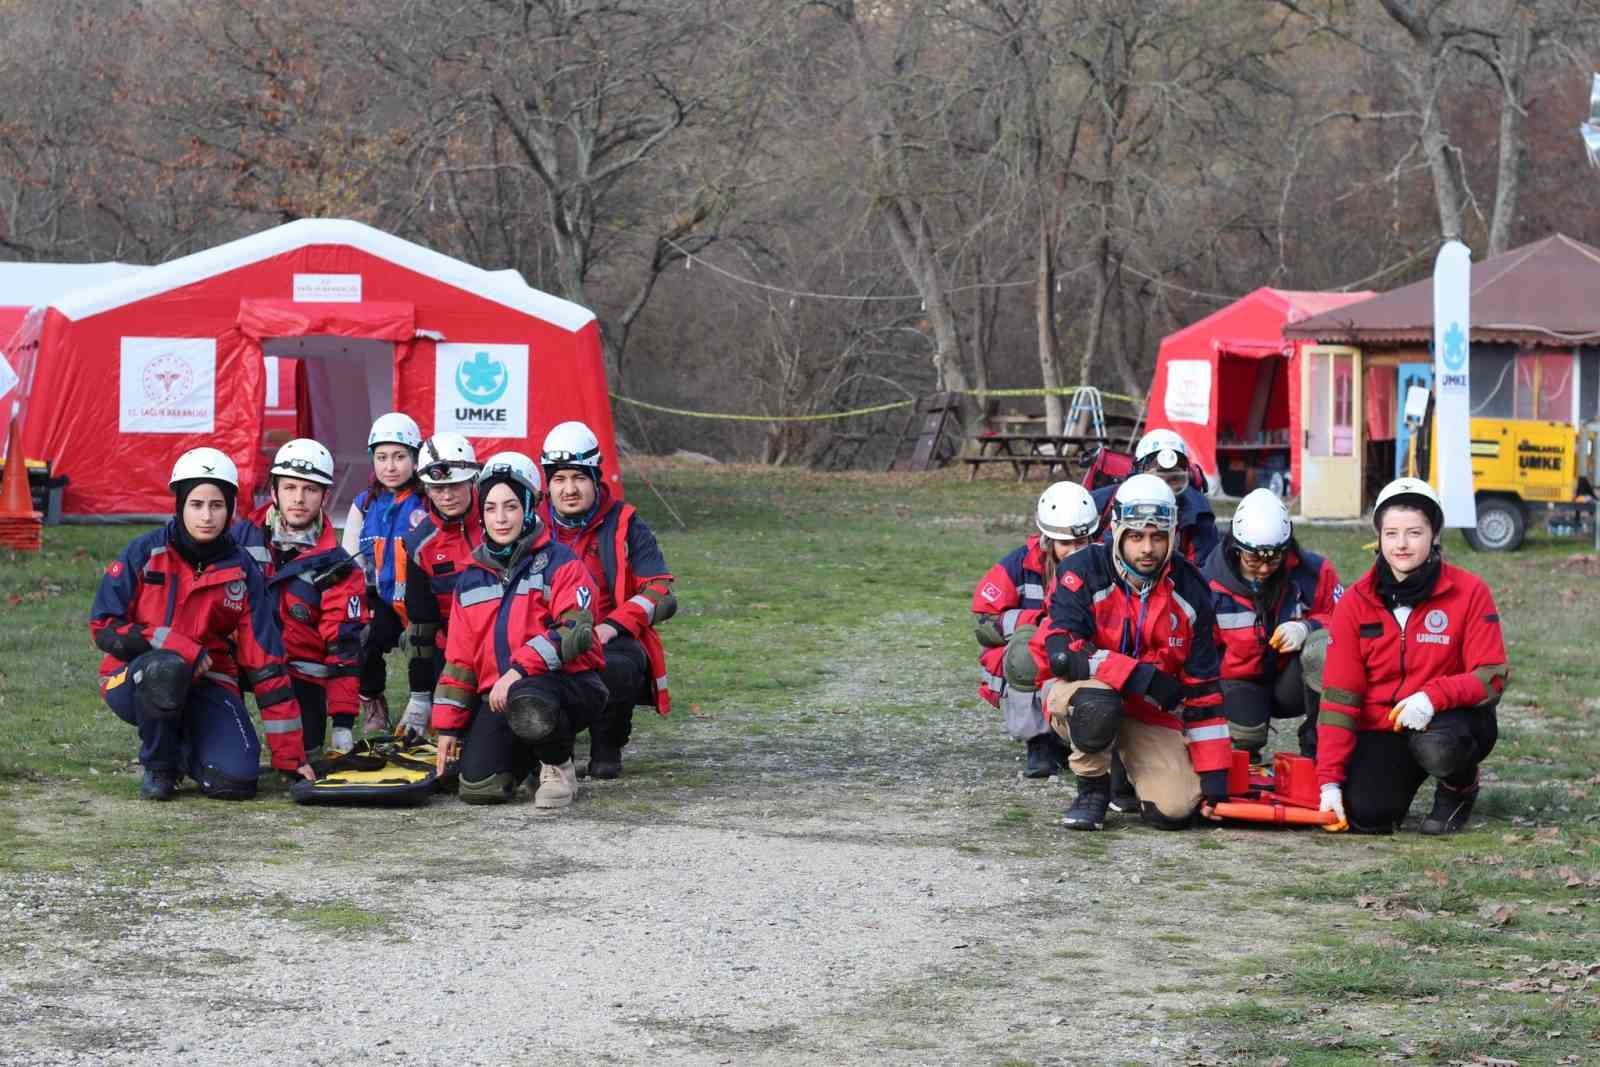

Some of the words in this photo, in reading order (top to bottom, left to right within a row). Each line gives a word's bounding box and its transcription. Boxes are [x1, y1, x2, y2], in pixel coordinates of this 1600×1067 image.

[1442, 375, 1467, 386] UMKE
[455, 407, 507, 422] UMKE
[1519, 455, 1562, 471] UMKE
